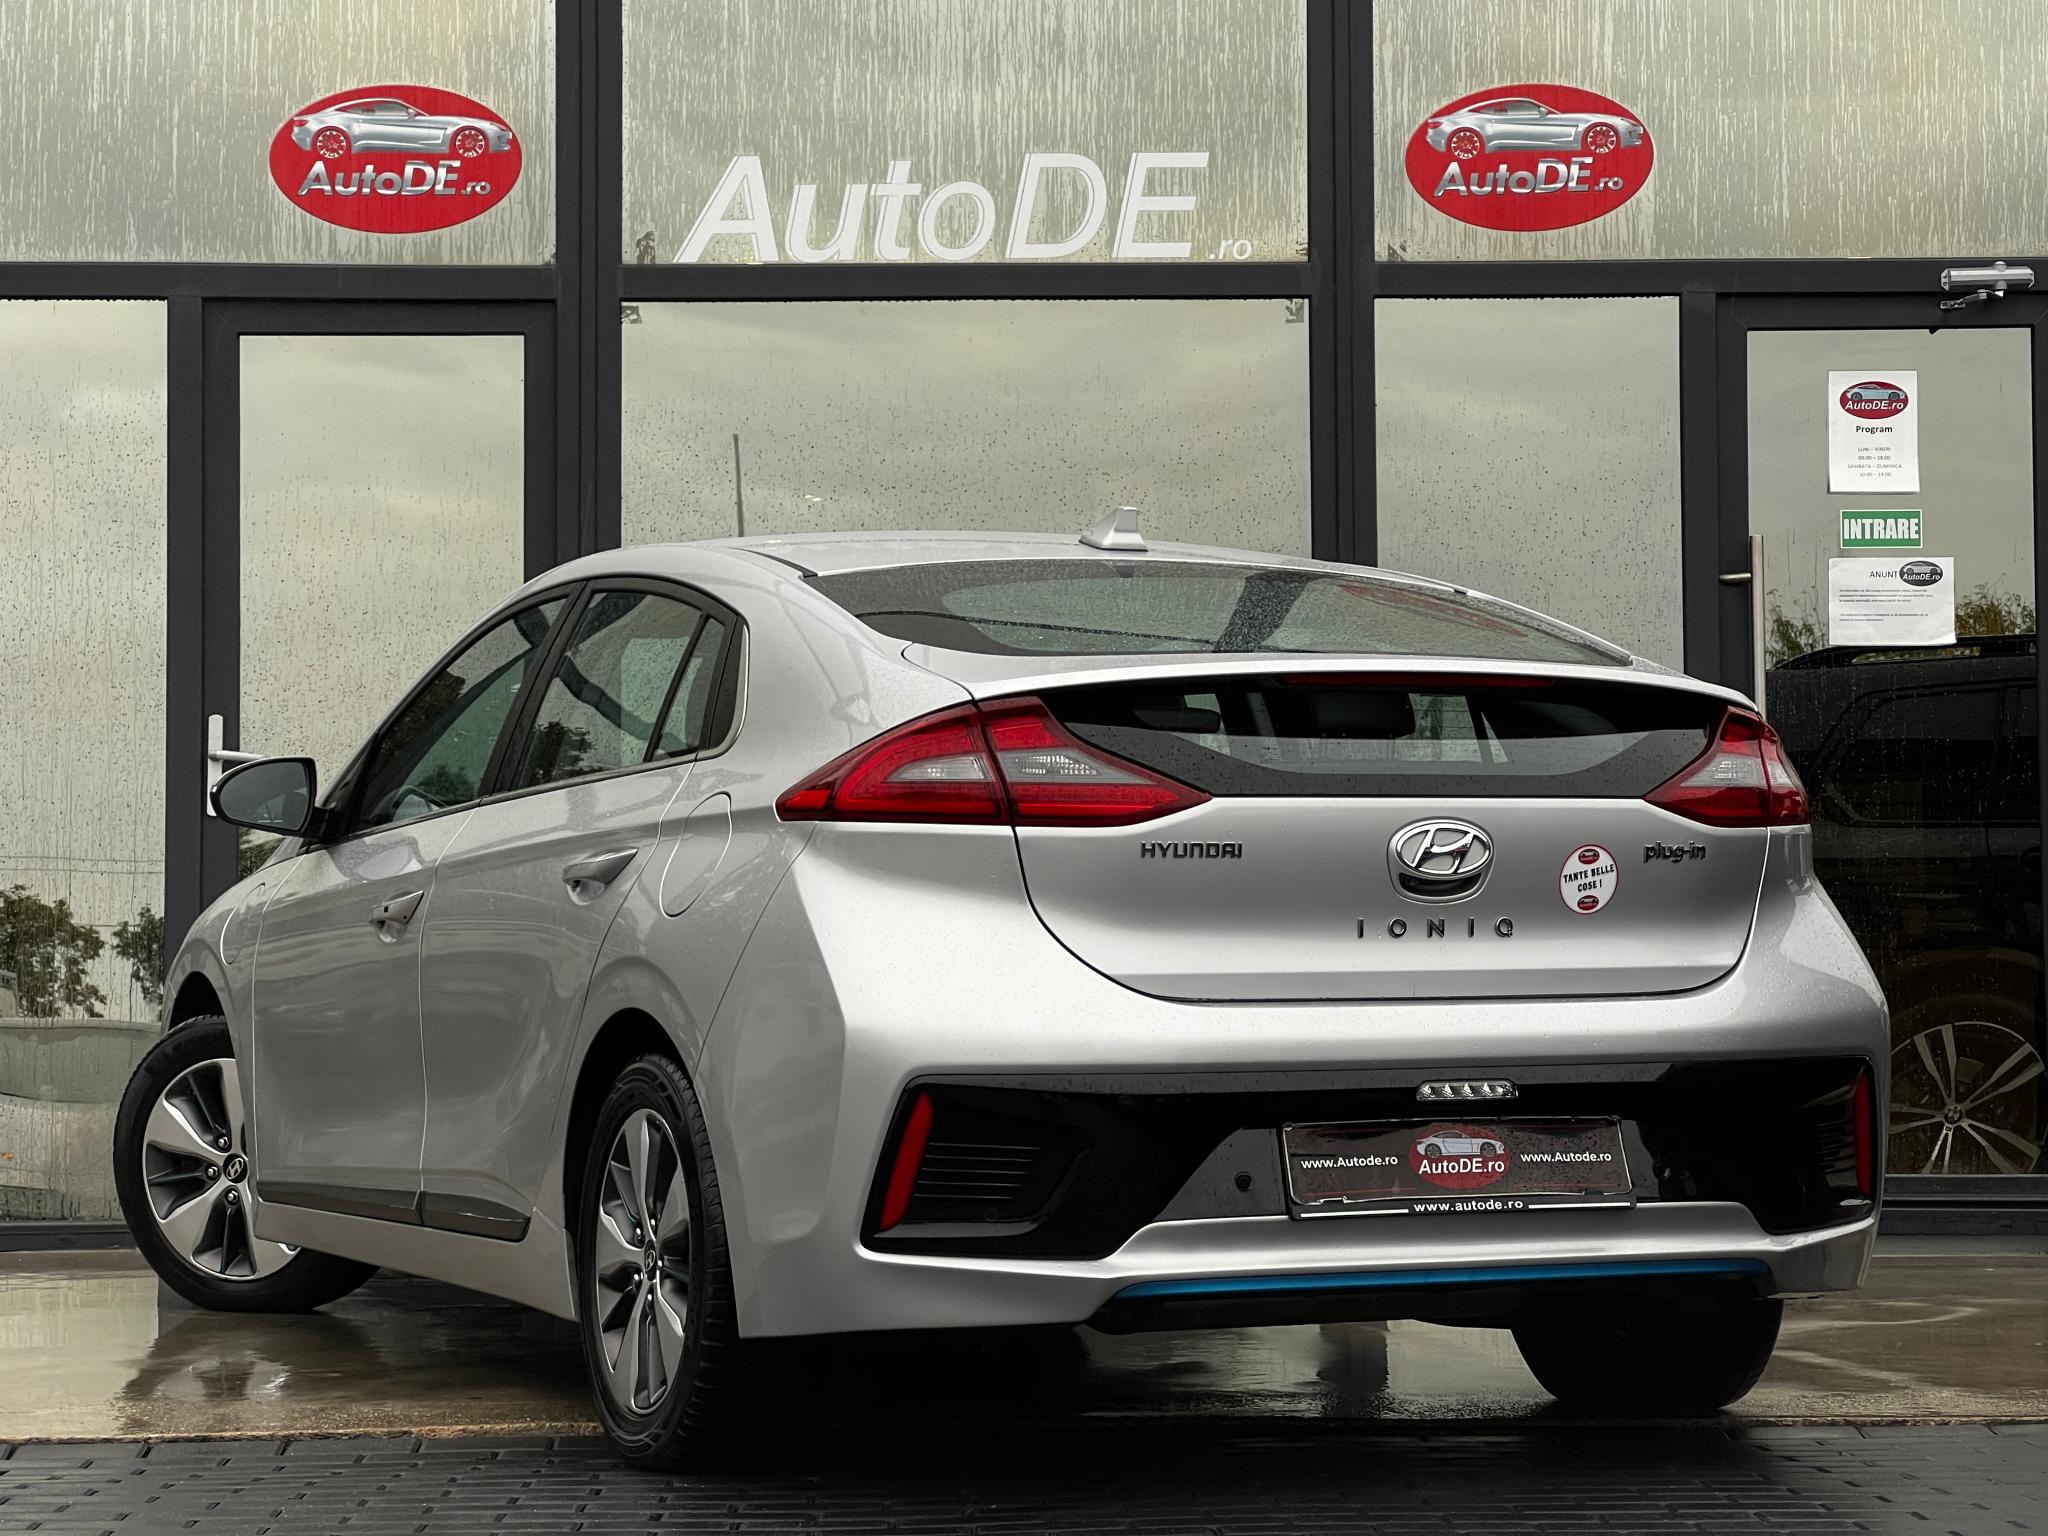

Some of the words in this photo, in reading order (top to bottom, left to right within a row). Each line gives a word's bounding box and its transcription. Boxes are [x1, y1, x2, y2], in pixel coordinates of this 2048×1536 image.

[1845, 400, 1904, 410] AutoDE.ro
[1855, 425, 1893, 435] Program
[1843, 518, 1920, 540] INTRARE
[1902, 573, 1941, 581] AutoDE.ro
[1140, 840, 1244, 860] HYUNDAI
[1643, 840, 1706, 864] plug-in
[1563, 869, 1589, 884] TANTE
[1590, 863, 1615, 878] BELLE
[1577, 880, 1598, 893] COSE
[1357, 916, 1514, 939] IONIQ
[1300, 1153, 1399, 1170] www.Autode.ro
[1519, 1150, 1613, 1164] www.Autode.ro
[1418, 1157, 1506, 1176] AutoDE.ro
[1413, 1198, 1524, 1213] www.autode.ro
